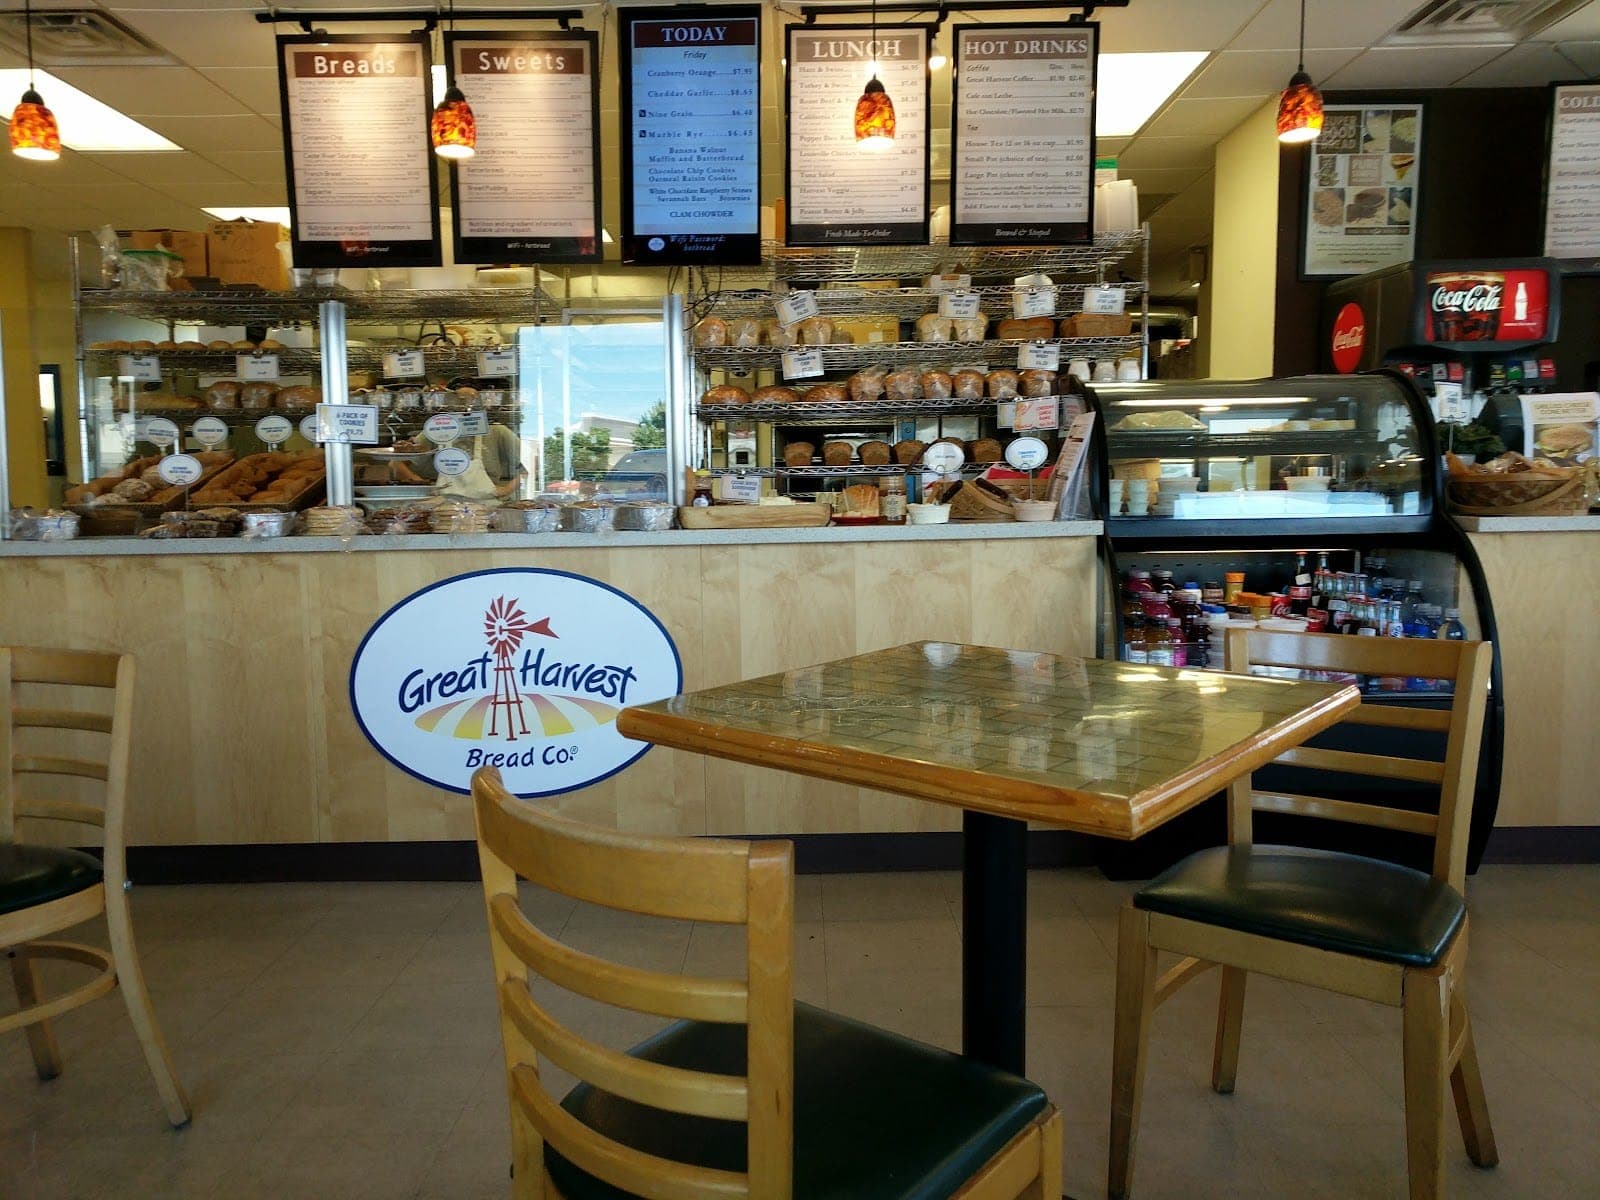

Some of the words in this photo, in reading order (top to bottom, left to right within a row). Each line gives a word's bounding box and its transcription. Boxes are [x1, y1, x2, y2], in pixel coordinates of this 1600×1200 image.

[661, 26, 728, 42] TODAY
[812, 39, 902, 58] LUNCH
[966, 41, 1008, 55] HOT
[1014, 40, 1088, 54] DRINKS
[683, 50, 708, 60] Friday
[313, 55, 396, 74] Breads
[478, 51, 565, 71] Sweets
[966, 64, 990, 72] Coffee
[647, 70, 685, 78] Cranberry
[688, 69, 717, 77] Orange
[647, 90, 684, 98] Cheddar
[687, 89, 714, 97] Garlic
[671, 110, 693, 118] Grain
[687, 130, 703, 139] Rye
[687, 167, 703, 176] Chip
[708, 174, 737, 182] Cookies
[693, 210, 735, 218] CHOWDER
[1432, 284, 1504, 313] Coca-Cola
[1332, 324, 1364, 352] Coca-Cola
[339, 419, 365, 427] COOKIES
[398, 651, 492, 713] Great
[520, 648, 637, 703] Harvest
[465, 746, 534, 767] Bread
